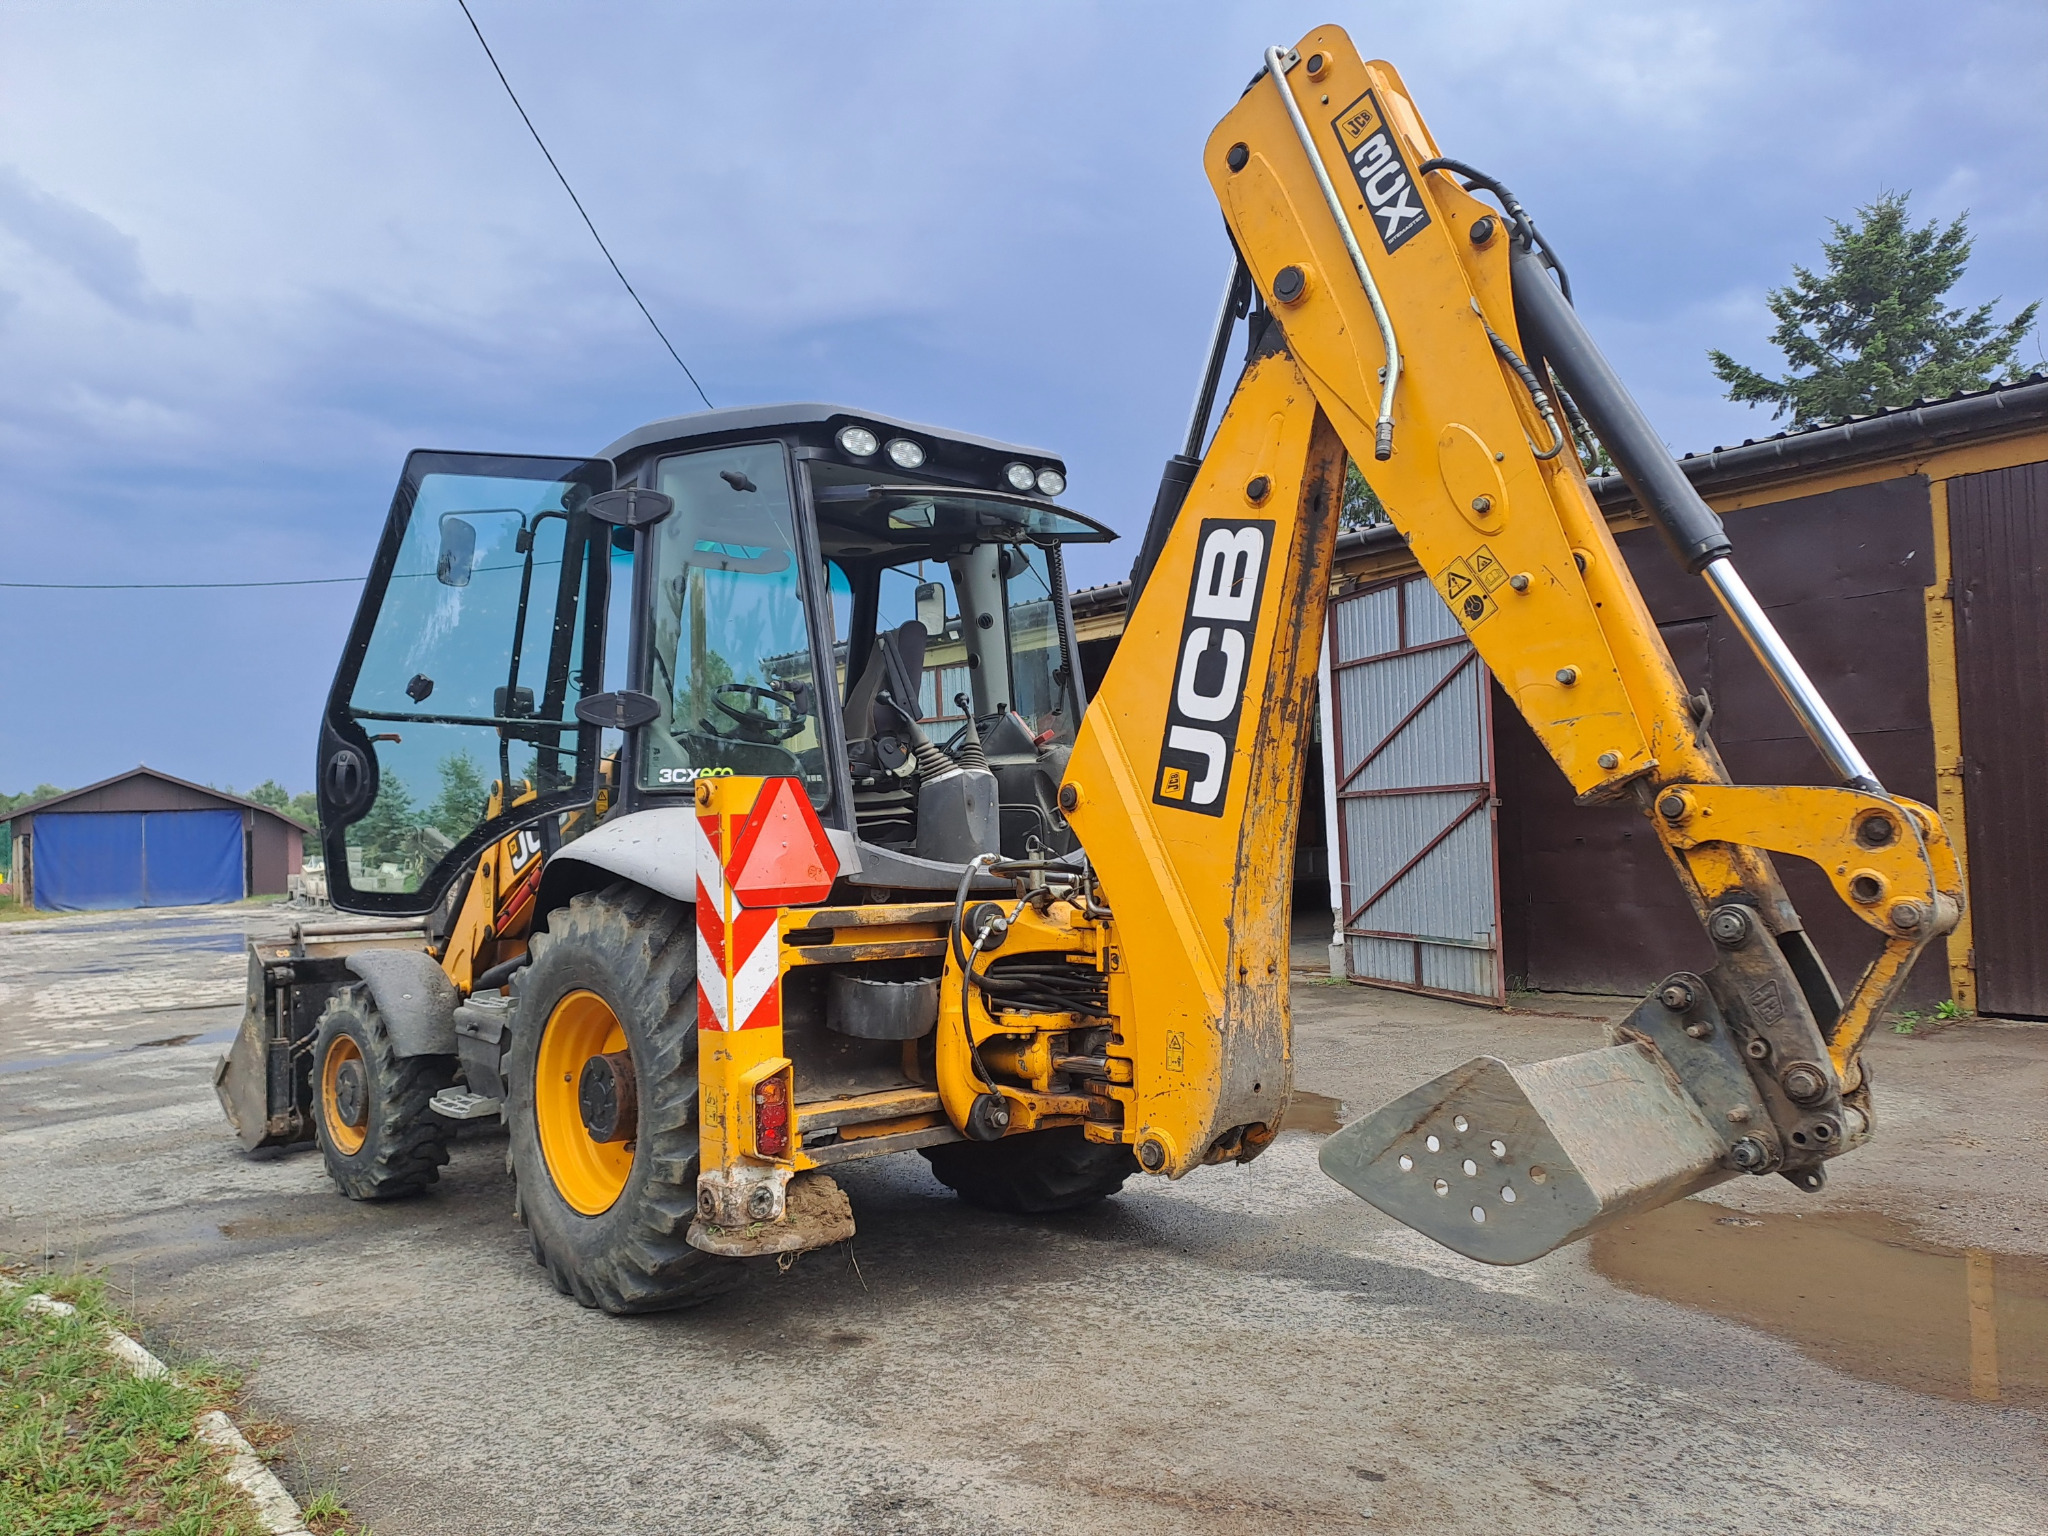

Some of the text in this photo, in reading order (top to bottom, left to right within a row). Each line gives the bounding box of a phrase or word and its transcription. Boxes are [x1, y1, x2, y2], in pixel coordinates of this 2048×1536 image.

[1347, 111, 1372, 135] JCB
[1354, 133, 1423, 240] 3CX
[1168, 526, 1265, 805] JCB
[1167, 773, 1180, 790] JCB
